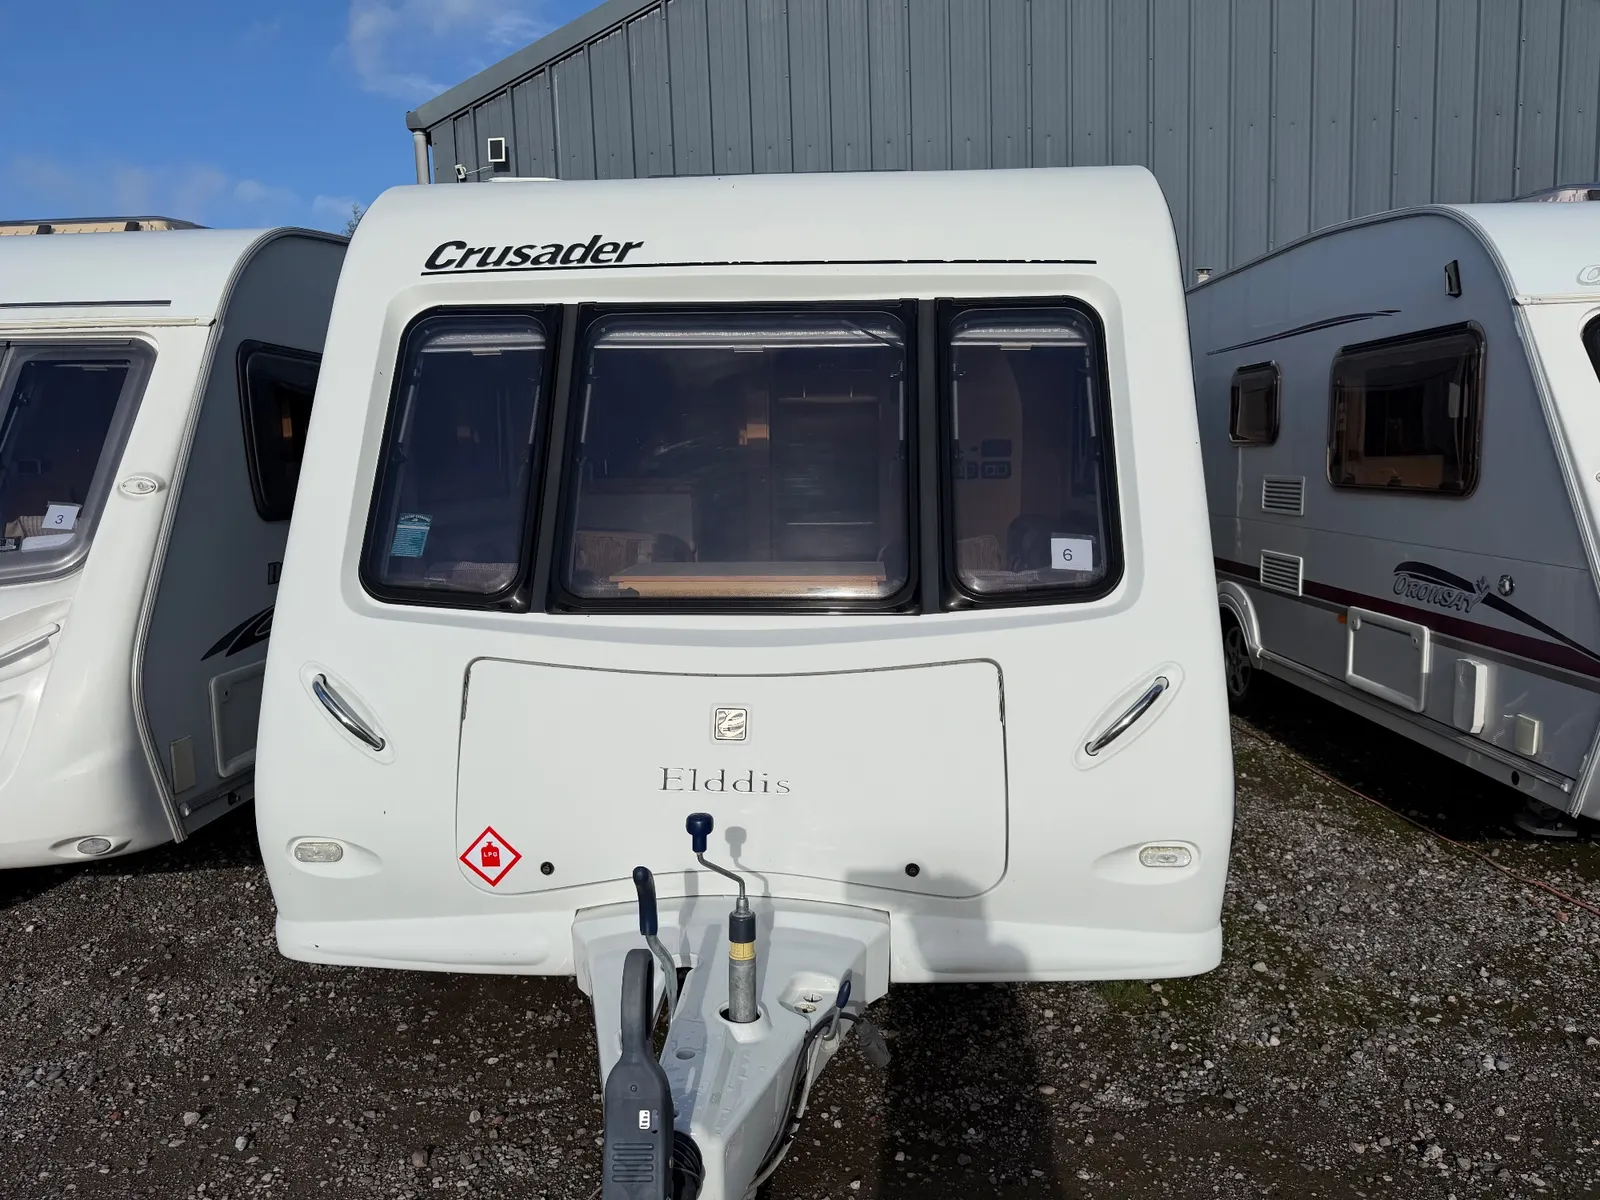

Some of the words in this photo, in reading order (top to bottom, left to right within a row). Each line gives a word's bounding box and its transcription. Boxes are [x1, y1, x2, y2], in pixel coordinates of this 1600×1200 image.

[424, 234, 645, 270] Crusader
[55, 514, 64, 525] 3
[1062, 548, 1073, 562] 6
[658, 766, 791, 795] Elddis
